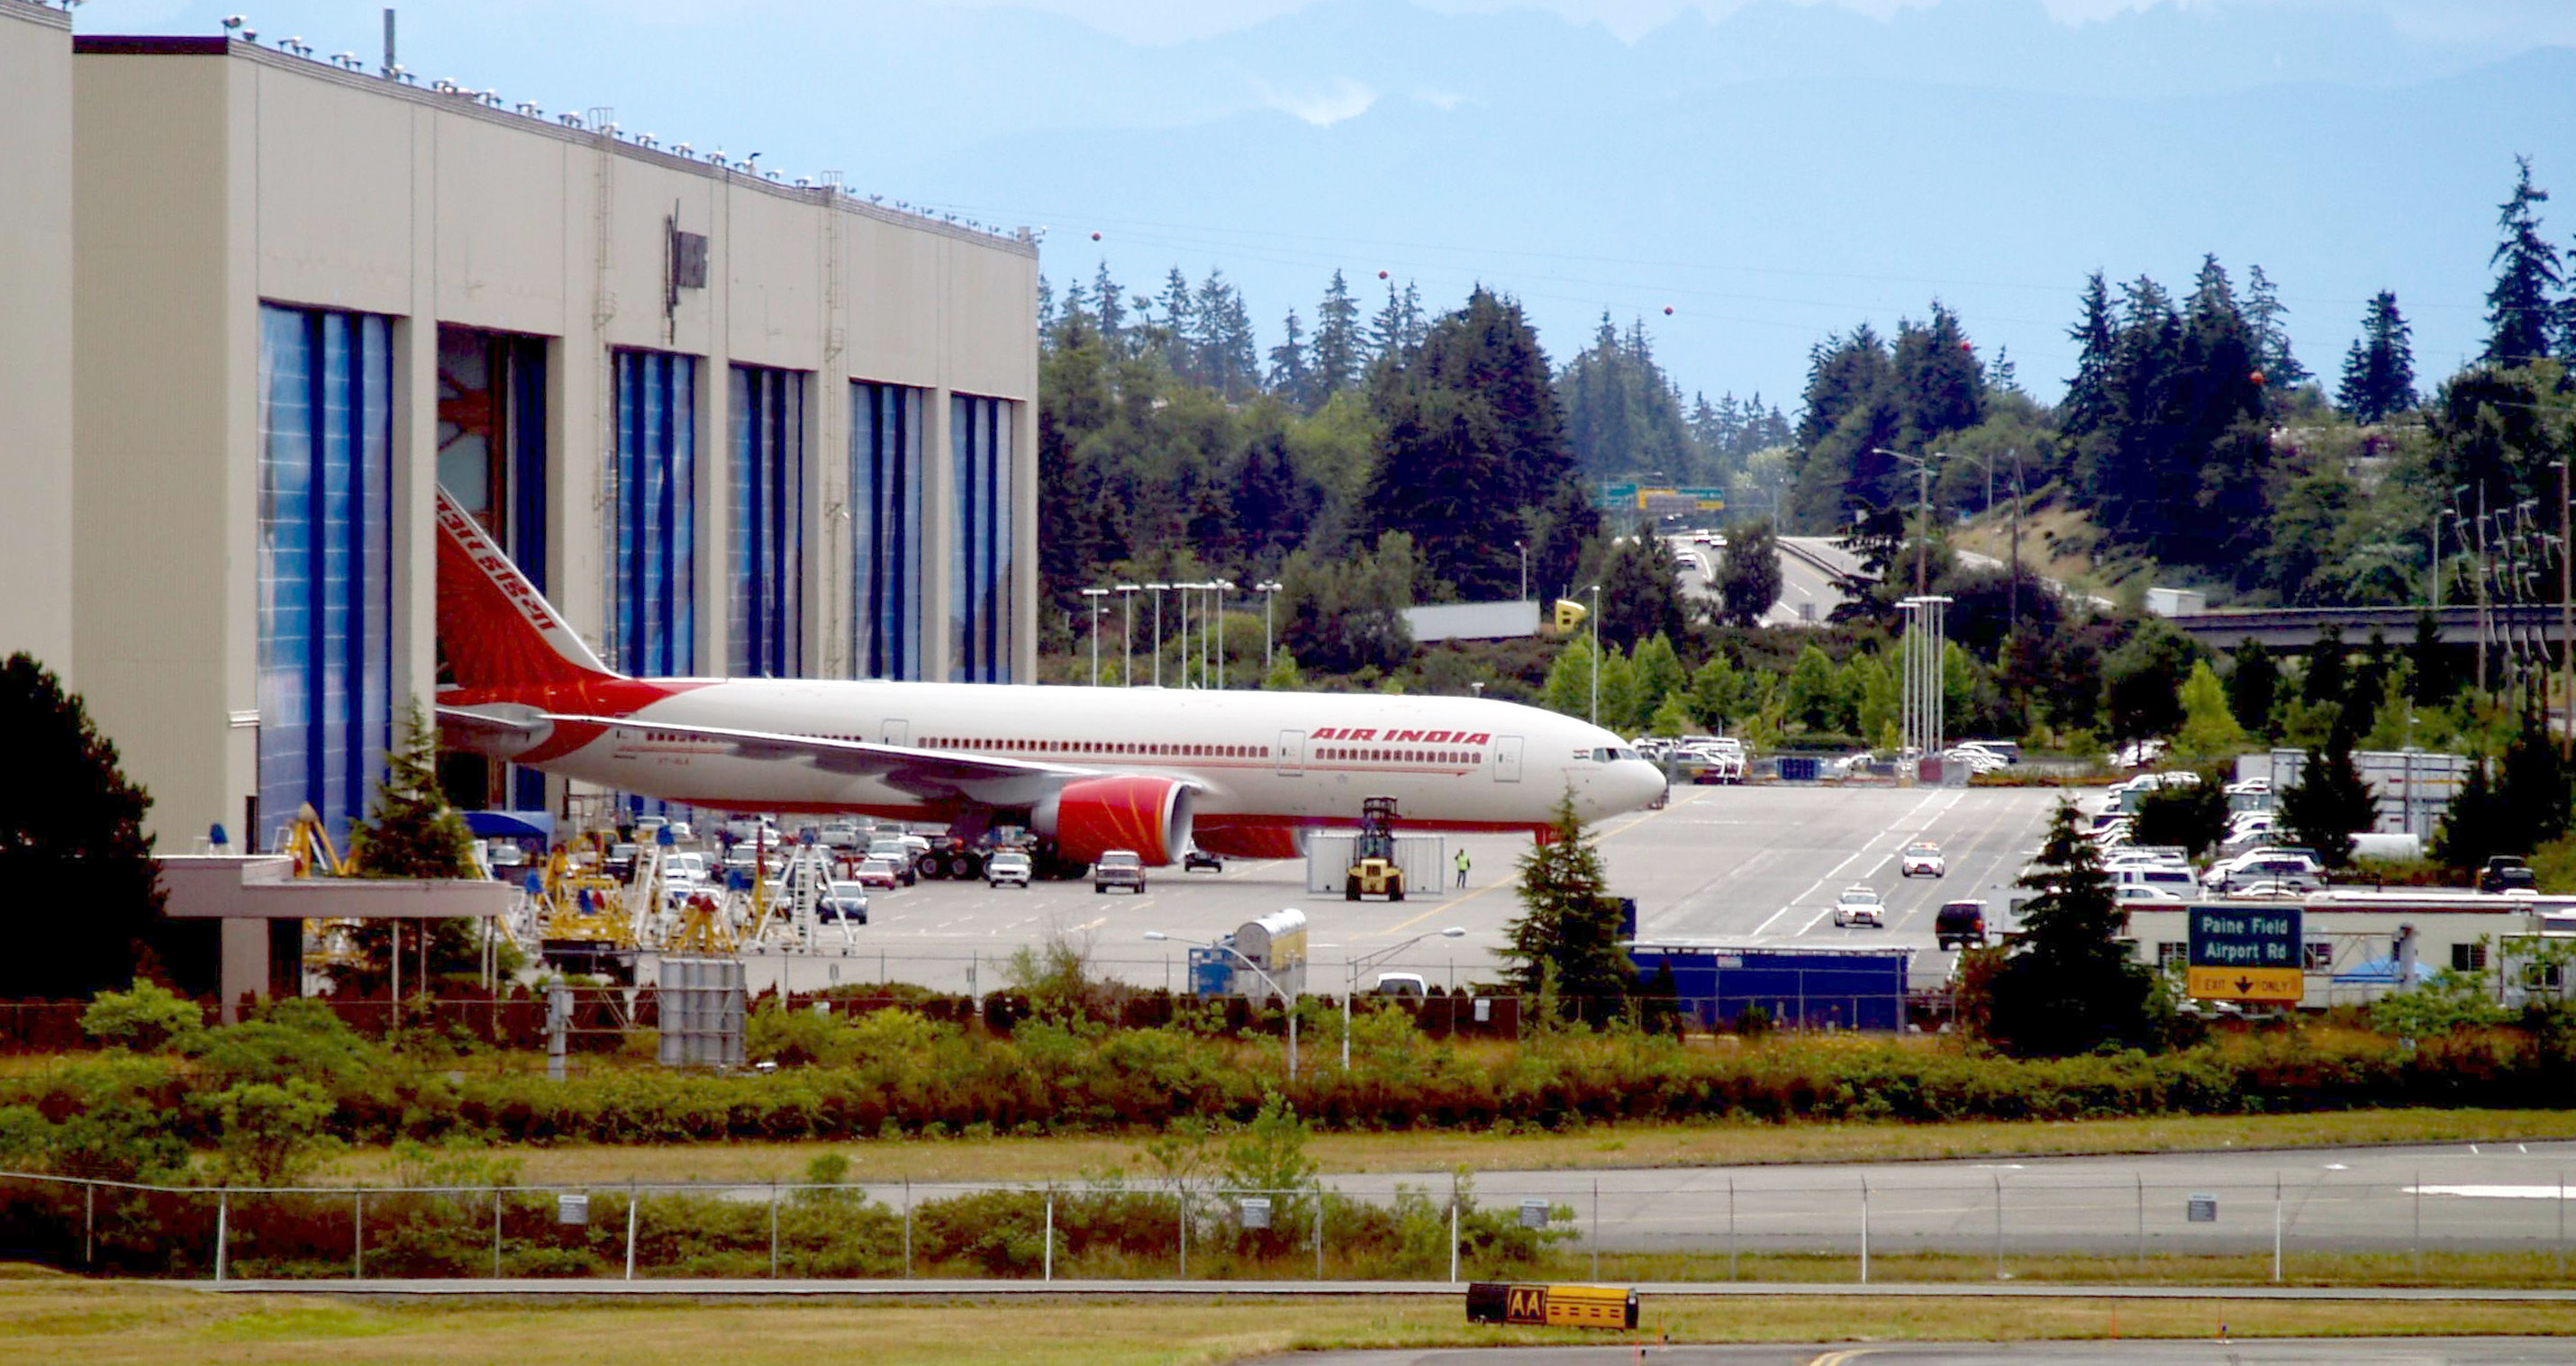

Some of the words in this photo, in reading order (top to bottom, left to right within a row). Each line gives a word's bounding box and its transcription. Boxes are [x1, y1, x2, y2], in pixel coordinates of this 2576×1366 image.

[1310, 728, 1378, 741] AIR
[1382, 729, 1492, 746] INDIA
[2202, 916, 2245, 935] Paine
[2252, 917, 2289, 936] Field
[2205, 942, 2260, 961] Airport
[2267, 943, 2287, 959] Rd
[2205, 979, 2226, 991] EXIT
[2262, 980, 2290, 993] ONLY
[1510, 1289, 1541, 1317] AA
